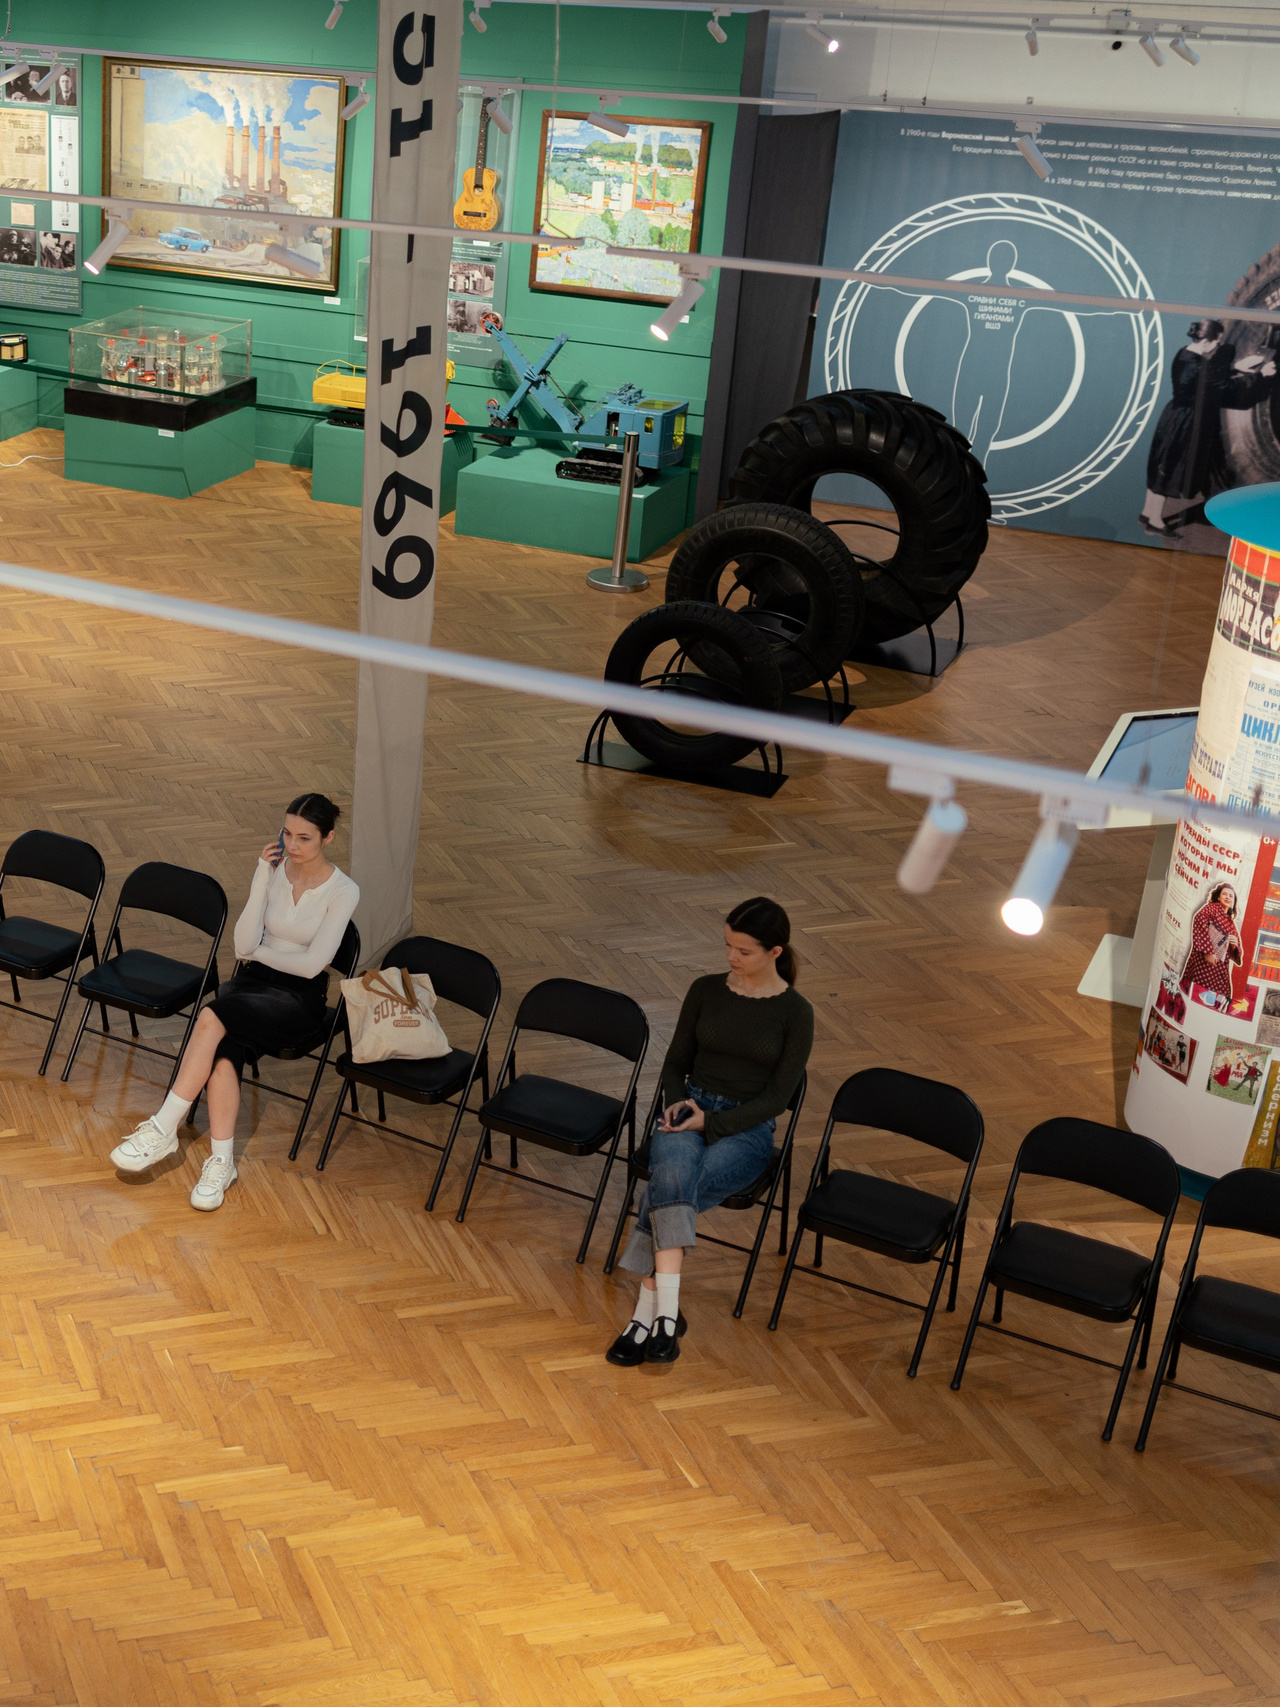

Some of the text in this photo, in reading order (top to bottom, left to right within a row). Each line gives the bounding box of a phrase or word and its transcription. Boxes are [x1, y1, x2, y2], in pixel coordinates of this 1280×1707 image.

[941, 131, 983, 140] Воронежский
[984, 134, 1010, 142] шинный
[1191, 149, 1261, 159] строительно-дорожной
[963, 146, 992, 154] продукция
[1095, 167, 1110, 175] 1966
[1111, 170, 1124, 178] году
[1126, 170, 1164, 179] предприятие
[1166, 172, 1182, 180] было
[1222, 176, 1252, 184] Орденом
[1057, 177, 1072, 186] 1968
[1073, 180, 1086, 188] году
[1122, 183, 1145, 191] первым
[1176, 186, 1226, 196] производителем
[1226, 191, 1272, 200] шин-гигантов
[968, 295, 1026, 308] СРАВНИ СЕБЯ С
[978, 304, 1012, 314] ШИНАМИ
[974, 312, 1014, 323] ГИГАНТАМИ
[985, 322, 1002, 330] ВШЗ
[371, 325, 435, 600] 1969
[1183, 820, 1210, 848] ТРЕНДЫ
[1212, 843, 1243, 864] СССР,
[1263, 836, 1276, 845] 0+
[1178, 848, 1210, 880] НОСИМ И
[1180, 834, 1238, 876] КОТОРЫЕ МЫ
[1174, 862, 1200, 890] СЕЙЧАС
